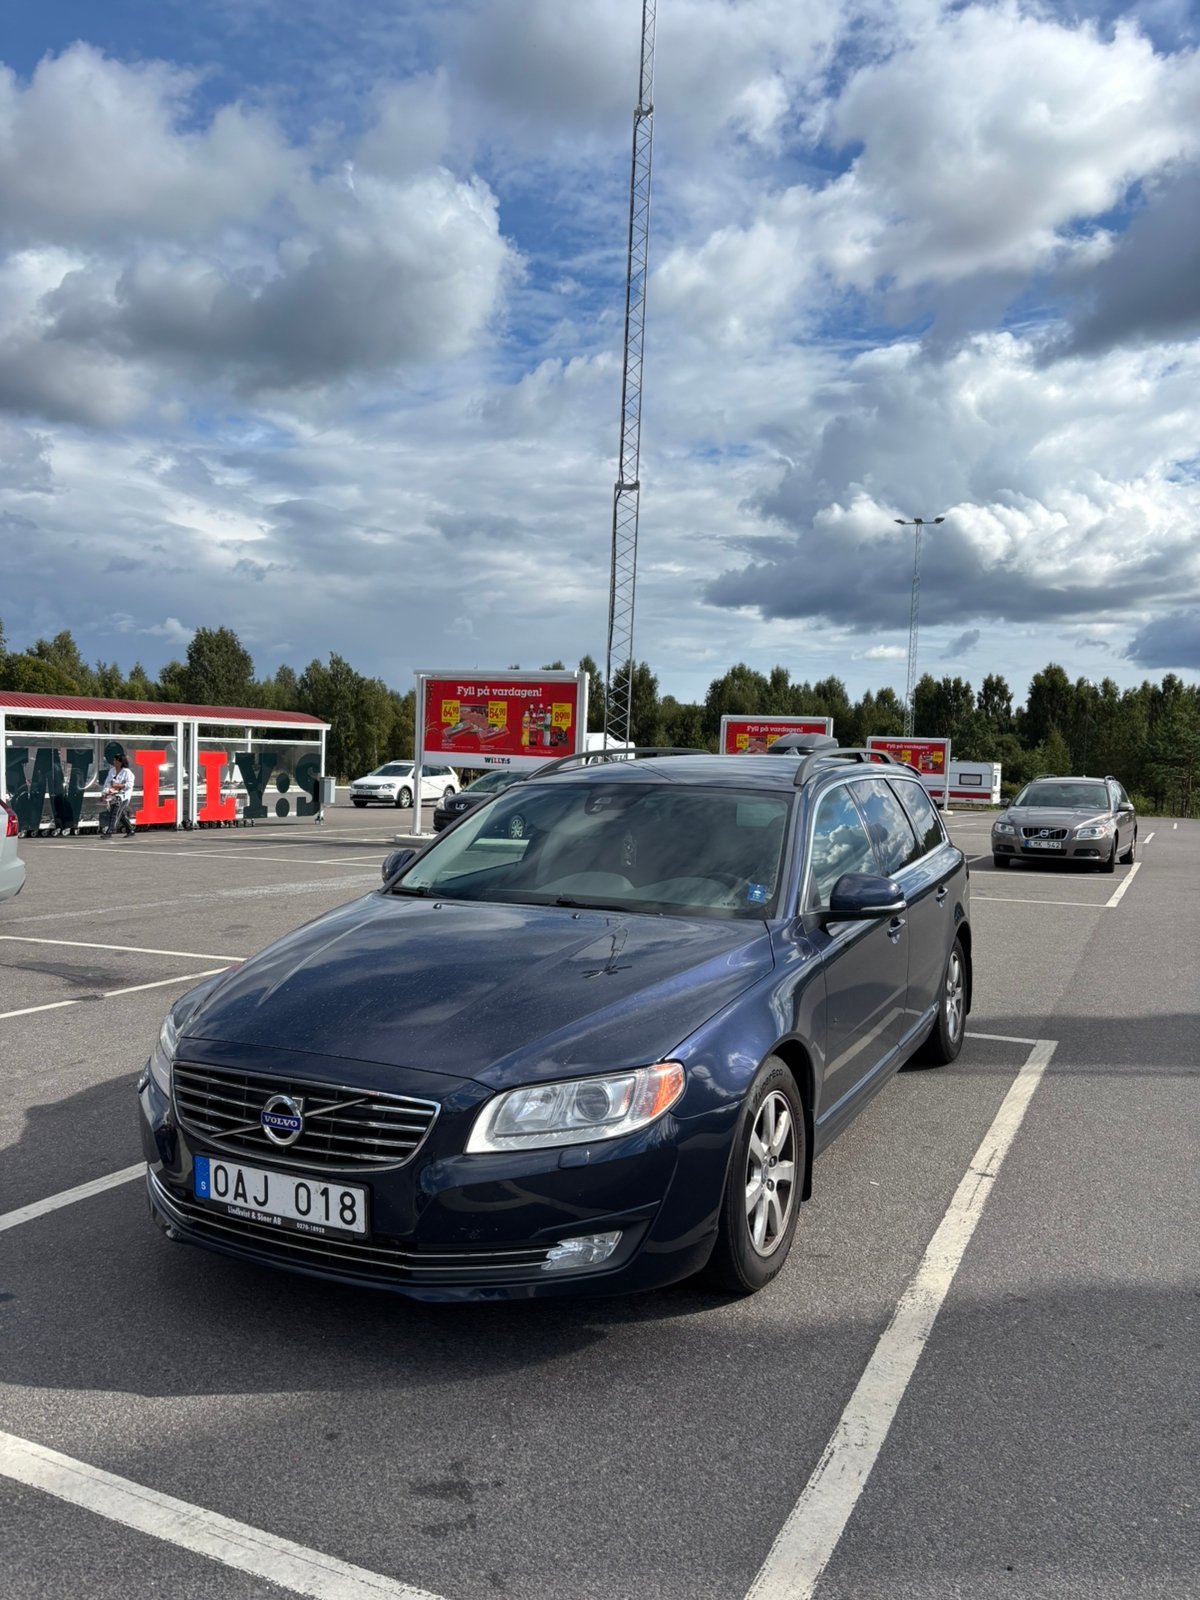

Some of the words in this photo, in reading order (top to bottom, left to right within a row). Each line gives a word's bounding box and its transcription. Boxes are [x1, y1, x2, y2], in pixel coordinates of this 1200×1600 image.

[456, 686, 475, 697] Fyll
[477, 685, 490, 697] på
[492, 687, 543, 698] vardagen!
[263, 1114, 299, 1128] VOLVO
[200, 1180, 207, 1191] S
[213, 1164, 269, 1208] OAJ
[294, 1181, 357, 1226] 018
[272, 1215, 282, 1226] AB
